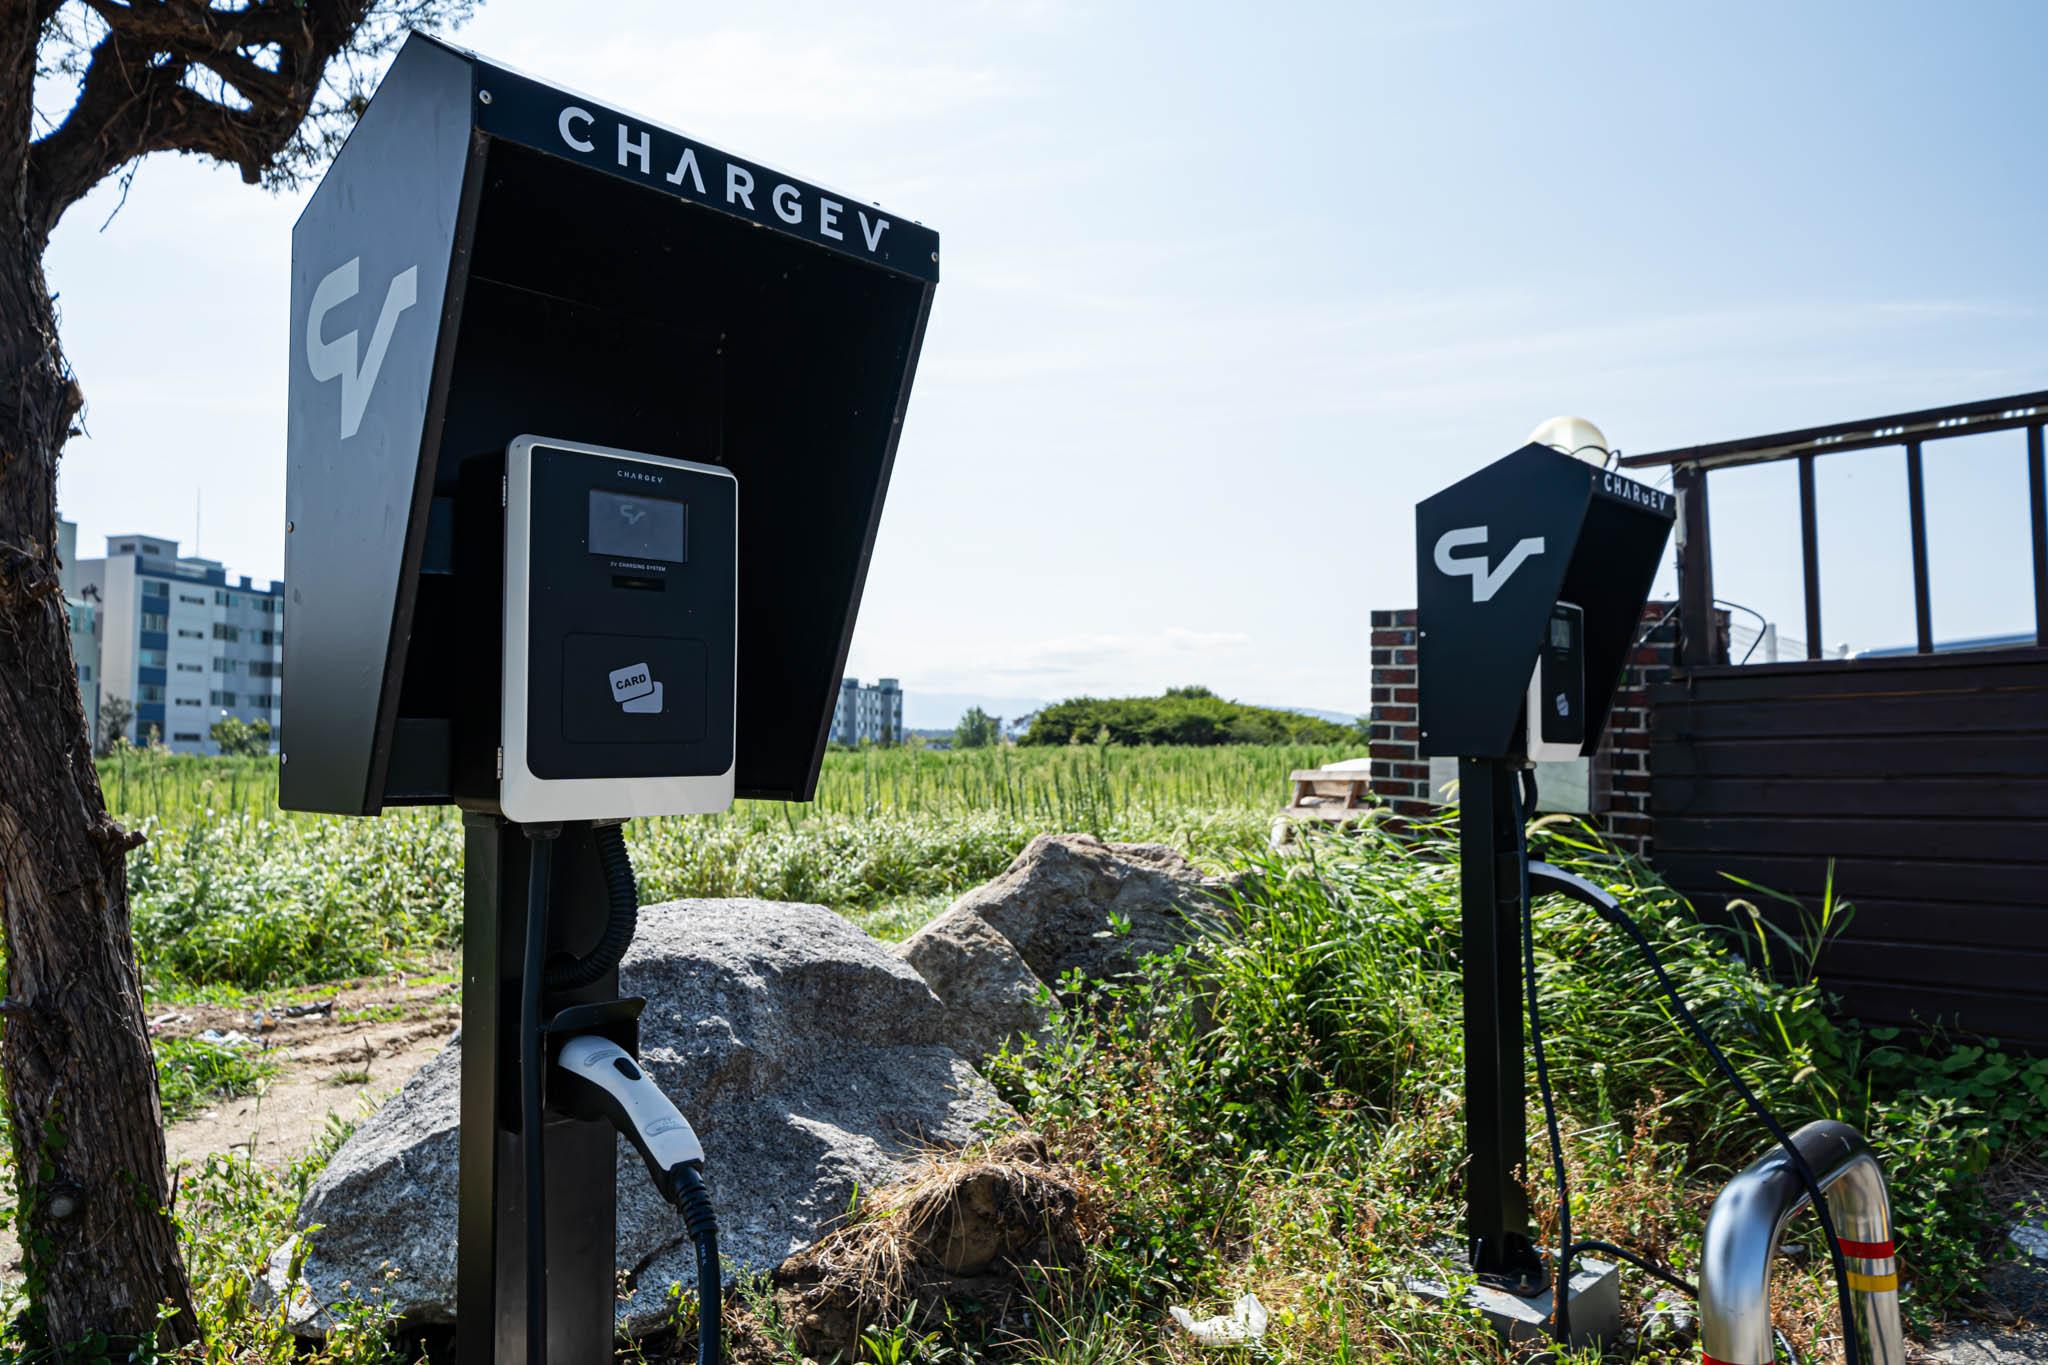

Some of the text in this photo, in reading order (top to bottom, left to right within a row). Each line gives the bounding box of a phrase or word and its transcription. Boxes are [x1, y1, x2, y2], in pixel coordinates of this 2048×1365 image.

[558, 105, 890, 253] CHARGEV
[617, 470, 663, 484] CHARGEV
[1603, 473, 1667, 511] CHARGEV
[616, 674, 646, 689] CARD
